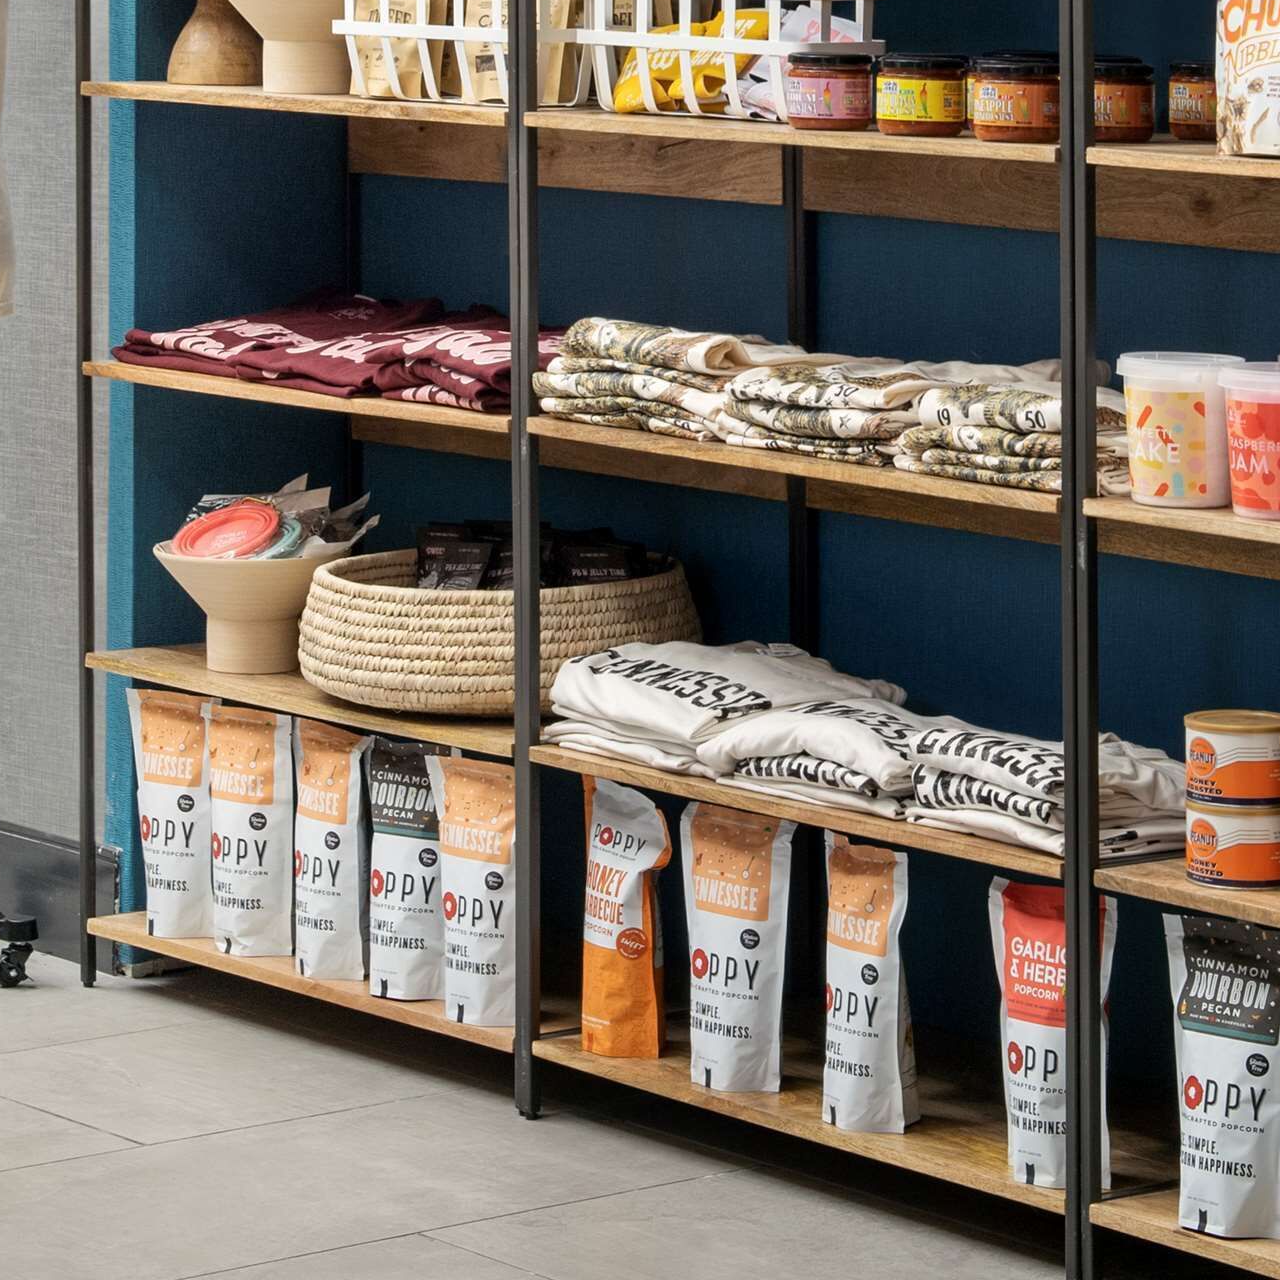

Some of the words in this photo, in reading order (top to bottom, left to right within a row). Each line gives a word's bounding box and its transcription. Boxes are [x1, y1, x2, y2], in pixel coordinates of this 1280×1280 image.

[937, 408, 951, 426] 19
[1025, 410, 1047, 429] 50
[1231, 451, 1269, 474] JAM
[1190, 750, 1215, 763] PEANUT
[377, 770, 430, 786] CINNAMO
[1190, 777, 1216, 787] HONEY
[1187, 782, 1223, 795] ROASTED
[383, 809, 414, 819] PECAN
[594, 823, 646, 856] POPPY
[1190, 831, 1216, 846] PEANUT
[1190, 858, 1217, 869] HONEY
[588, 859, 629, 898] HONEY
[381, 935, 428, 951] HAPPINESS.
[1011, 937, 1067, 965] GARLIC
[455, 960, 500, 976] HAPPINESS.
[1010, 958, 1019, 978] &
[1196, 956, 1271, 980] CINNAMON
[722, 988, 760, 1001] POPCORN
[1014, 984, 1059, 1001] POPCORN
[695, 1001, 720, 1019] SIMPLE.
[1201, 1001, 1241, 1018] PECAN
[704, 1018, 753, 1040] HAPPINESS.
[827, 1058, 873, 1079] HAPPINESS.
[1221, 1122, 1265, 1134] POPCORN
[1188, 1135, 1219, 1156] SIMPLE.
[1199, 1155, 1256, 1178] HAPPINESS.
